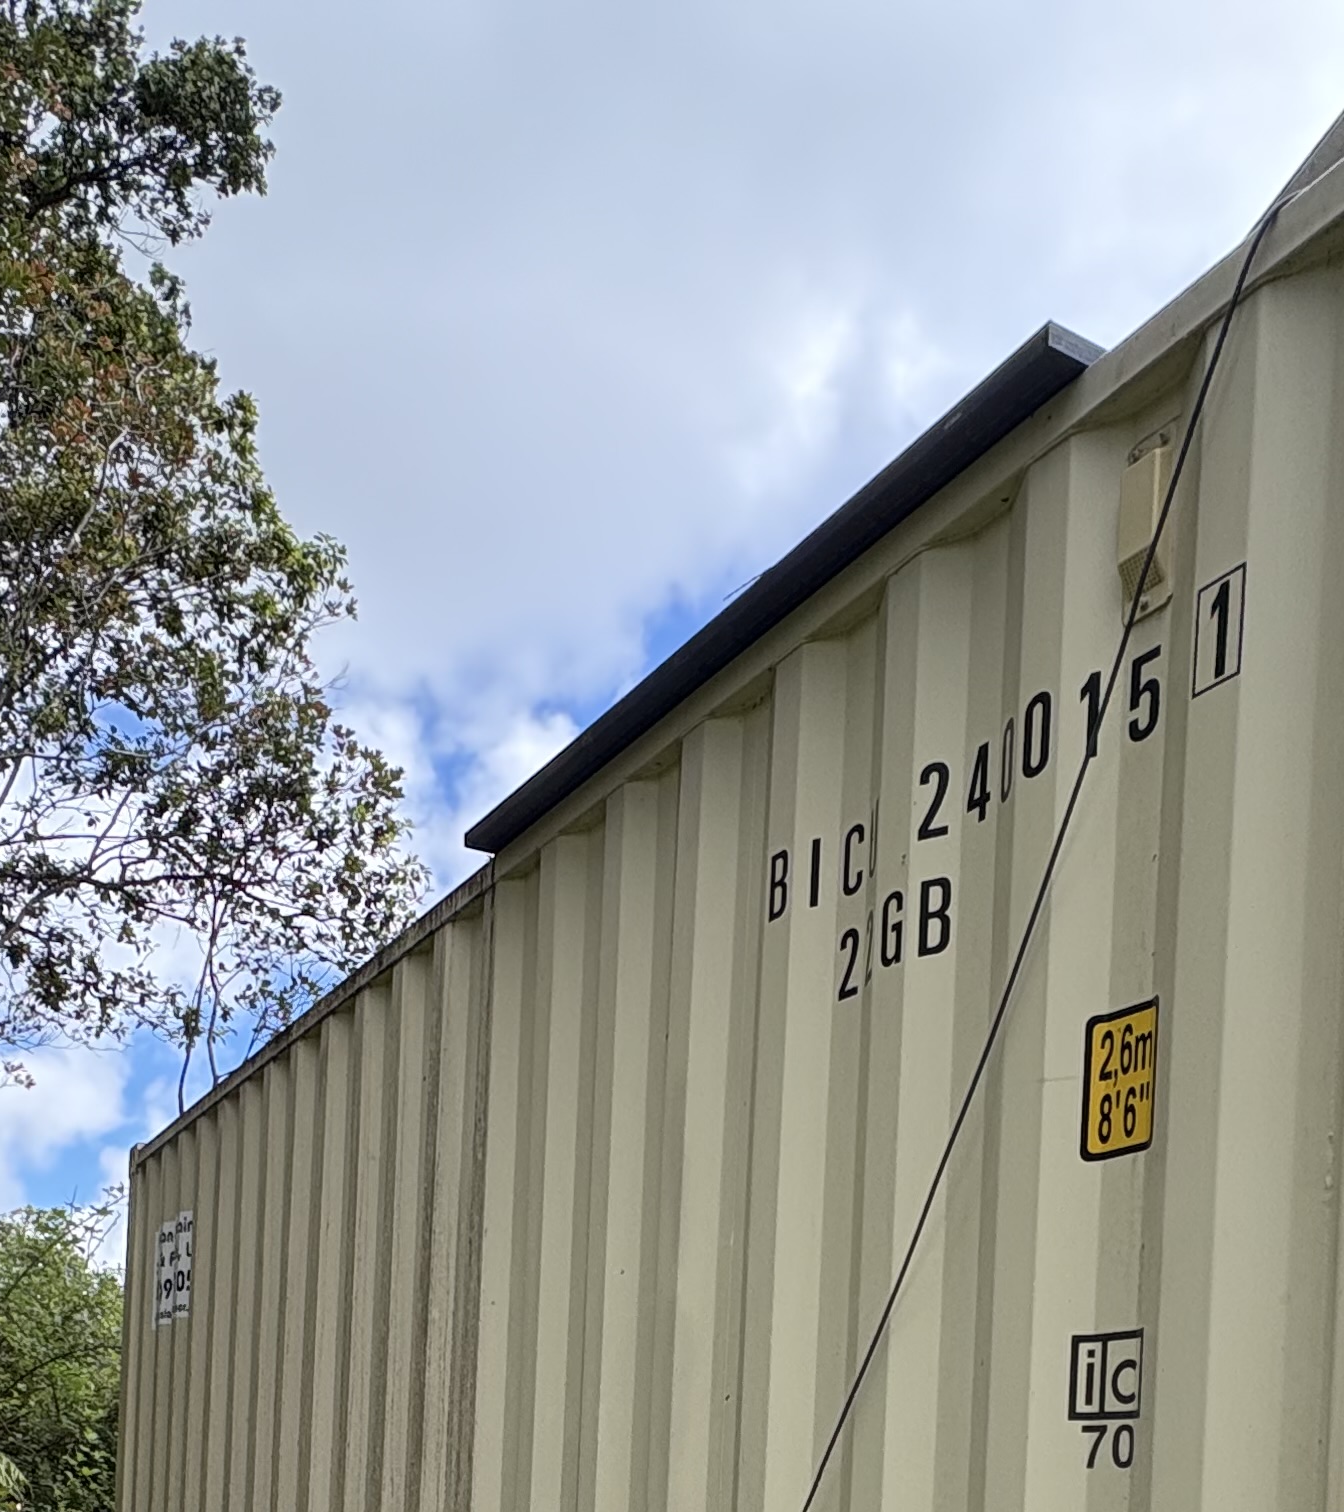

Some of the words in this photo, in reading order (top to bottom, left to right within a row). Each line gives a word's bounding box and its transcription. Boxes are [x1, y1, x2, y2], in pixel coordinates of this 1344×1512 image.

[1208, 579, 1231, 680] 1
[1097, 1080, 1150, 1145] 8'6"
[1080, 1425, 1135, 1469] 70
